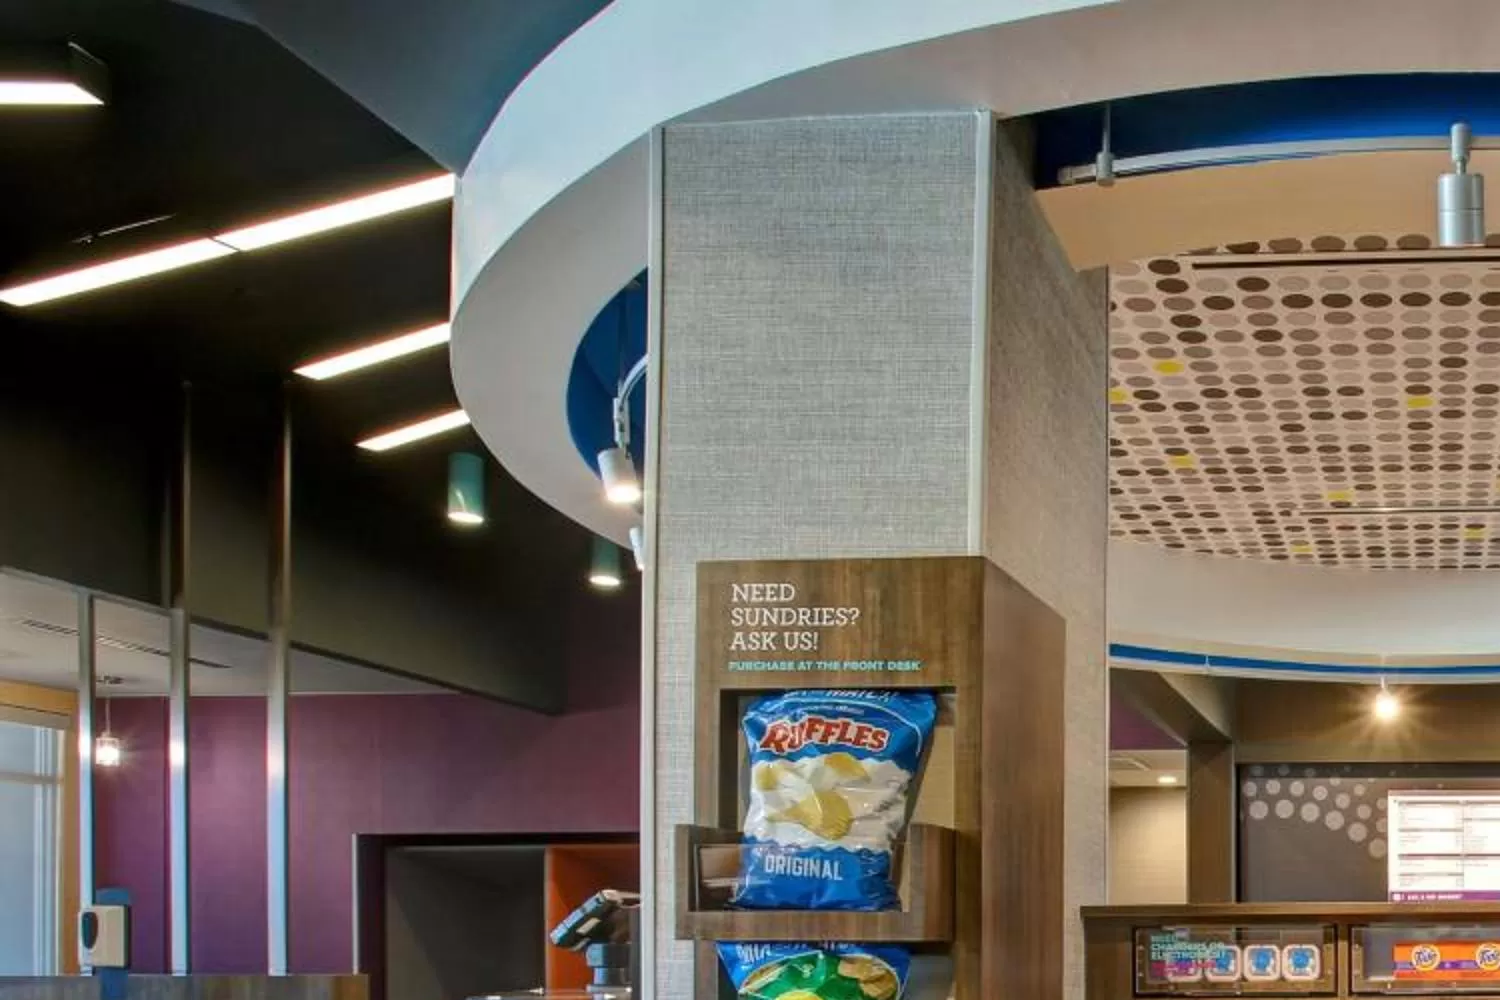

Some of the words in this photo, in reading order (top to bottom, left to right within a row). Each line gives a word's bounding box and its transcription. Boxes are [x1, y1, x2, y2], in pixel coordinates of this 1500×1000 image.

[731, 584, 796, 602] NEED
[730, 607, 860, 627] SUNDRIES?
[729, 632, 776, 651] ASK
[784, 632, 819, 650] US!
[728, 660, 794, 671] PURCHASE
[798, 661, 812, 671] AT
[816, 661, 840, 671] THE
[843, 661, 884, 671] FRONT
[887, 661, 922, 671] DESK
[760, 715, 891, 754] RUFFLES
[765, 854, 842, 881] ORIGINAL
